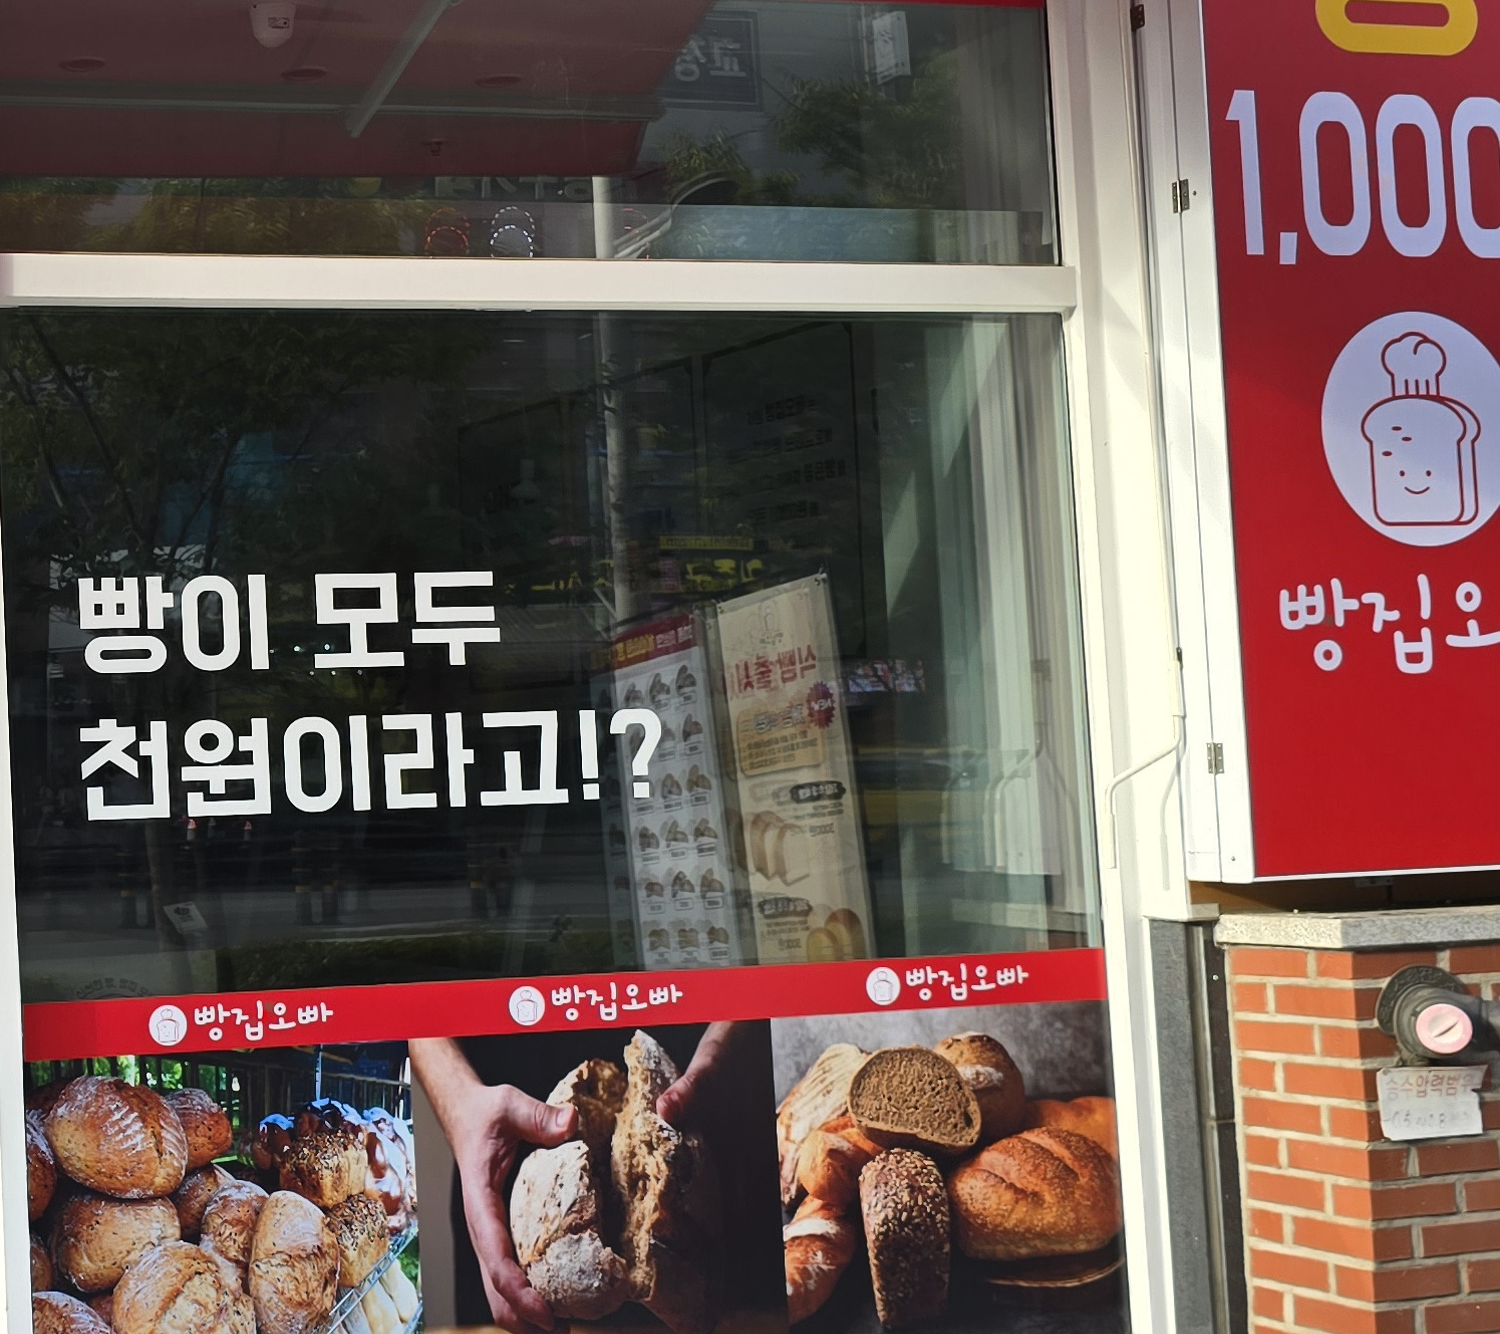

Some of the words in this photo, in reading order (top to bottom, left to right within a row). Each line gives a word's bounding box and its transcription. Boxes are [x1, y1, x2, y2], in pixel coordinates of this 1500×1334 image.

[78, 572, 270, 675] 빵이
[314, 570, 501, 669] 모두
[80, 708, 662, 821] 천원이라고!?
[550, 980, 684, 1022] 빵집오빠
[906, 963, 1029, 1002] 빵집오빠
[194, 999, 334, 1043] 빵집오빠
